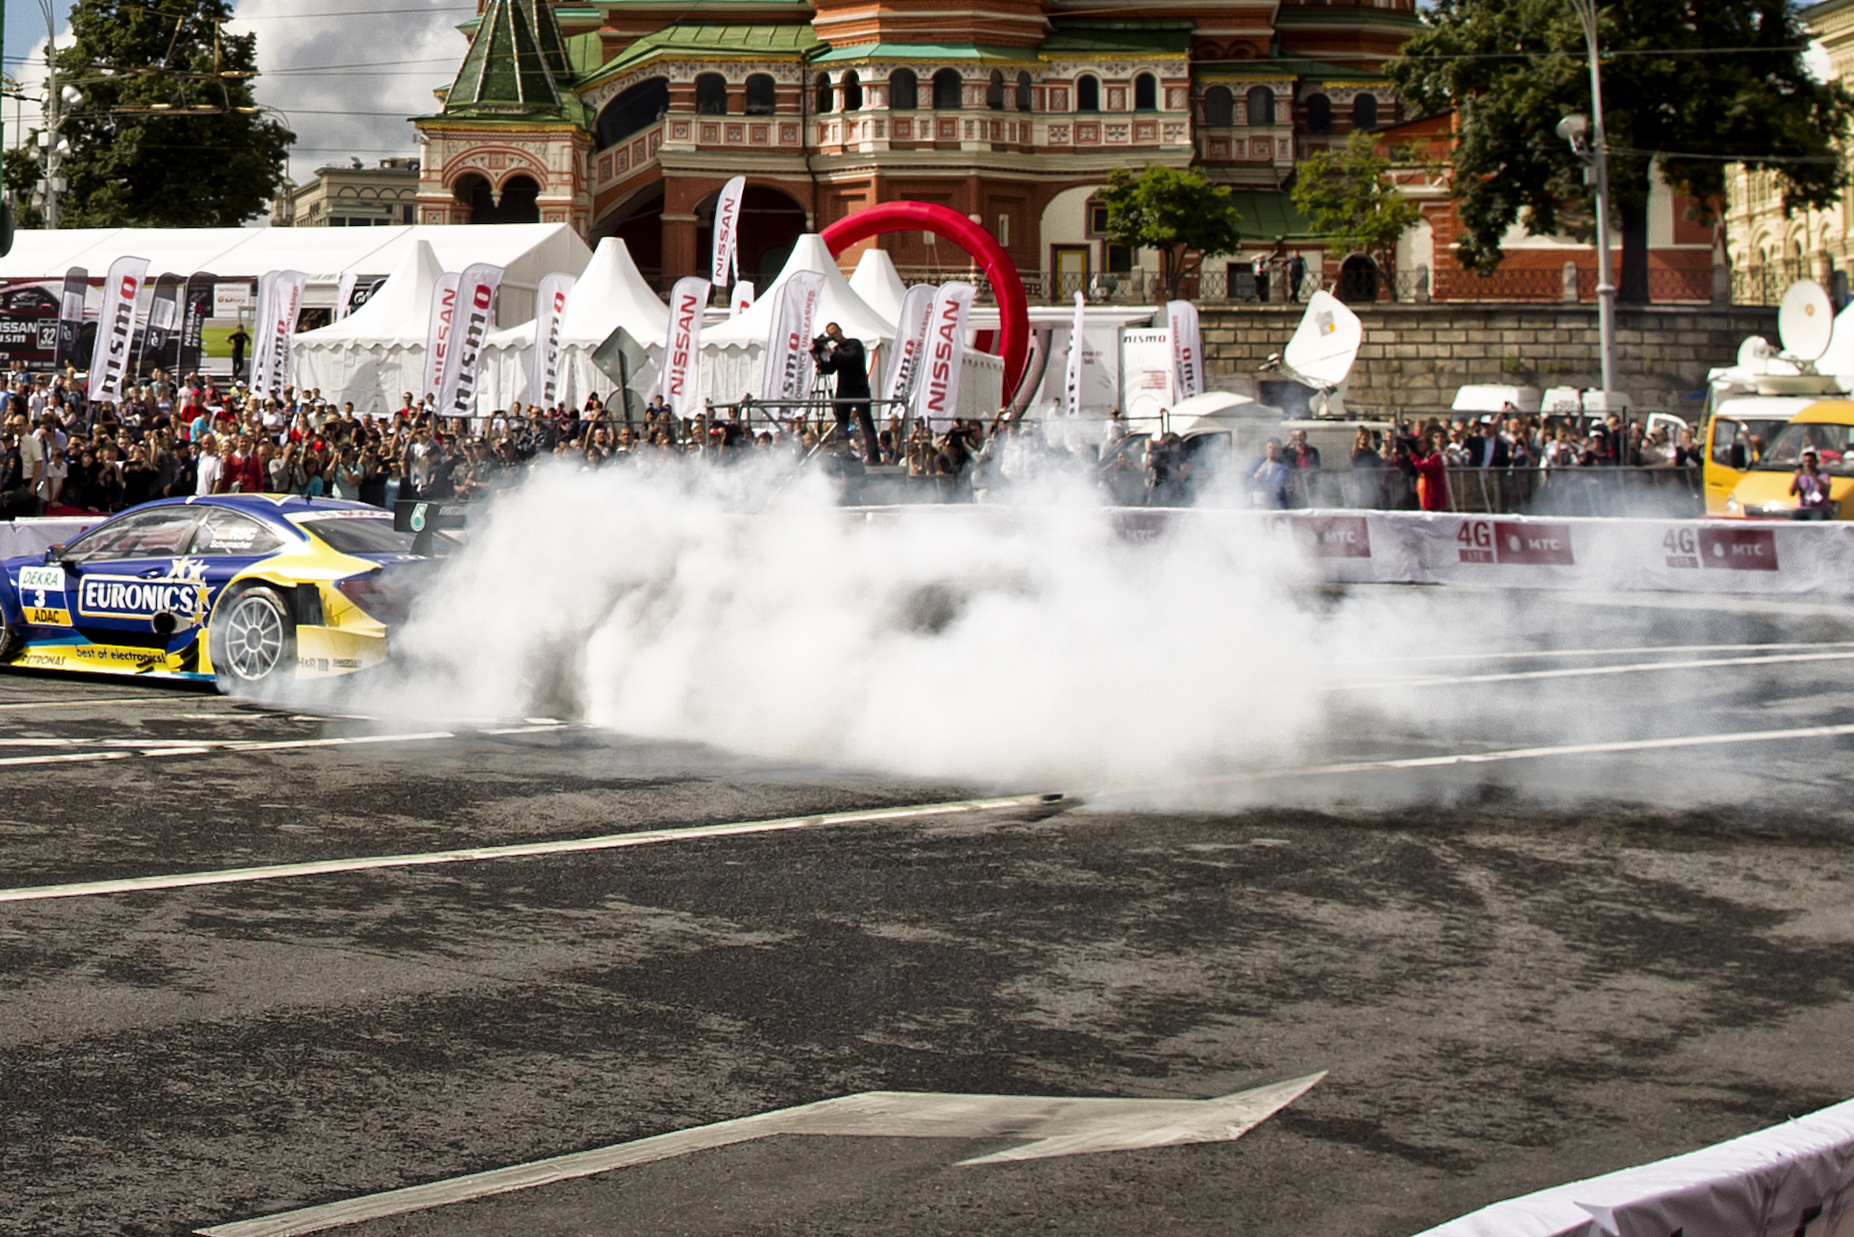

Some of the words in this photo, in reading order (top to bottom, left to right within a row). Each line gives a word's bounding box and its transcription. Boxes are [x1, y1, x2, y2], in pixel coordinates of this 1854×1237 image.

[716, 198, 736, 278] NISSAN
[184, 302, 196, 346] NISSAN
[286, 285, 299, 333] UNLEASHED
[801, 290, 816, 348] UNLEASHED
[41, 328, 56, 344] 32
[101, 276, 137, 393] nismo
[671, 295, 697, 396] NISSAN
[915, 302, 933, 354] UNLEASHED
[1123, 335, 1166, 343] nismo
[454, 284, 491, 410] nismo
[544, 292, 565, 402] nismo
[928, 300, 961, 411] NISSAN
[229, 527, 257, 540] RSC
[1457, 520, 1491, 548] 4G
[1662, 527, 1695, 554] 4G
[22, 571, 58, 587] DEKRA
[86, 582, 193, 612] EURONICS
[34, 589, 46, 608] 3
[34, 609, 59, 623] ADAC
[76, 648, 95, 658] best
[98, 647, 107, 659] of
[111, 648, 166, 664] electronics!
